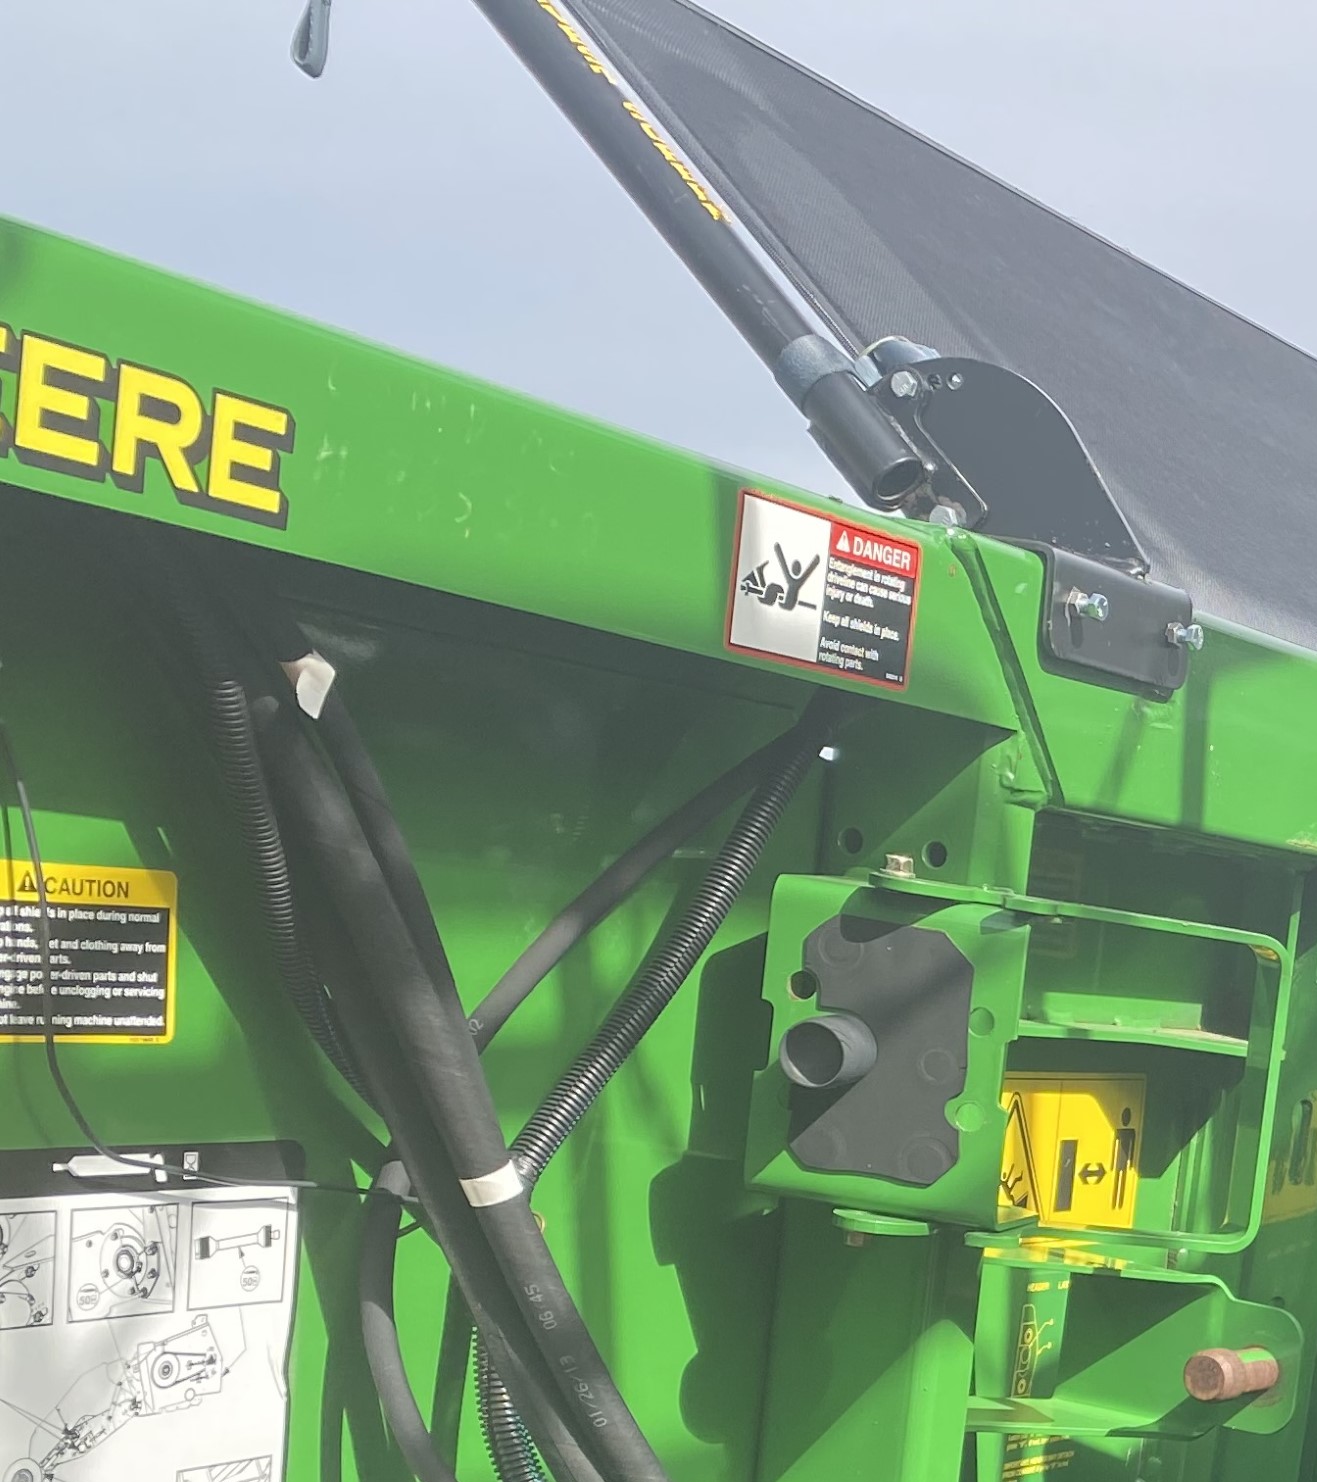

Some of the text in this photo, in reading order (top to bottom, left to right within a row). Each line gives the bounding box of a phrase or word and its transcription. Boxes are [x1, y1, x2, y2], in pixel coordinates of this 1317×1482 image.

[0, 323, 293, 526] ERE
[853, 537, 910, 570] DANGER
[845, 592, 853, 602] or
[856, 582, 868, 592] can
[869, 585, 888, 598] cause
[823, 610, 899, 641] Keep all shields in place.
[820, 637, 878, 661] Avoid contact with
[819, 652, 863, 670] rotating parts.
[44, 876, 129, 898] CAUTION
[57, 907, 160, 923] in place during normal
[60, 940, 166, 954] and clothing away from
[49, 954, 71, 964] arts.
[93, 971, 158, 983] parts and shut
[59, 985, 165, 1000] unclogging or servicing
[74, 1015, 165, 1026] machine unattended.
[559, 1355, 607, 1428] 01/26/13
